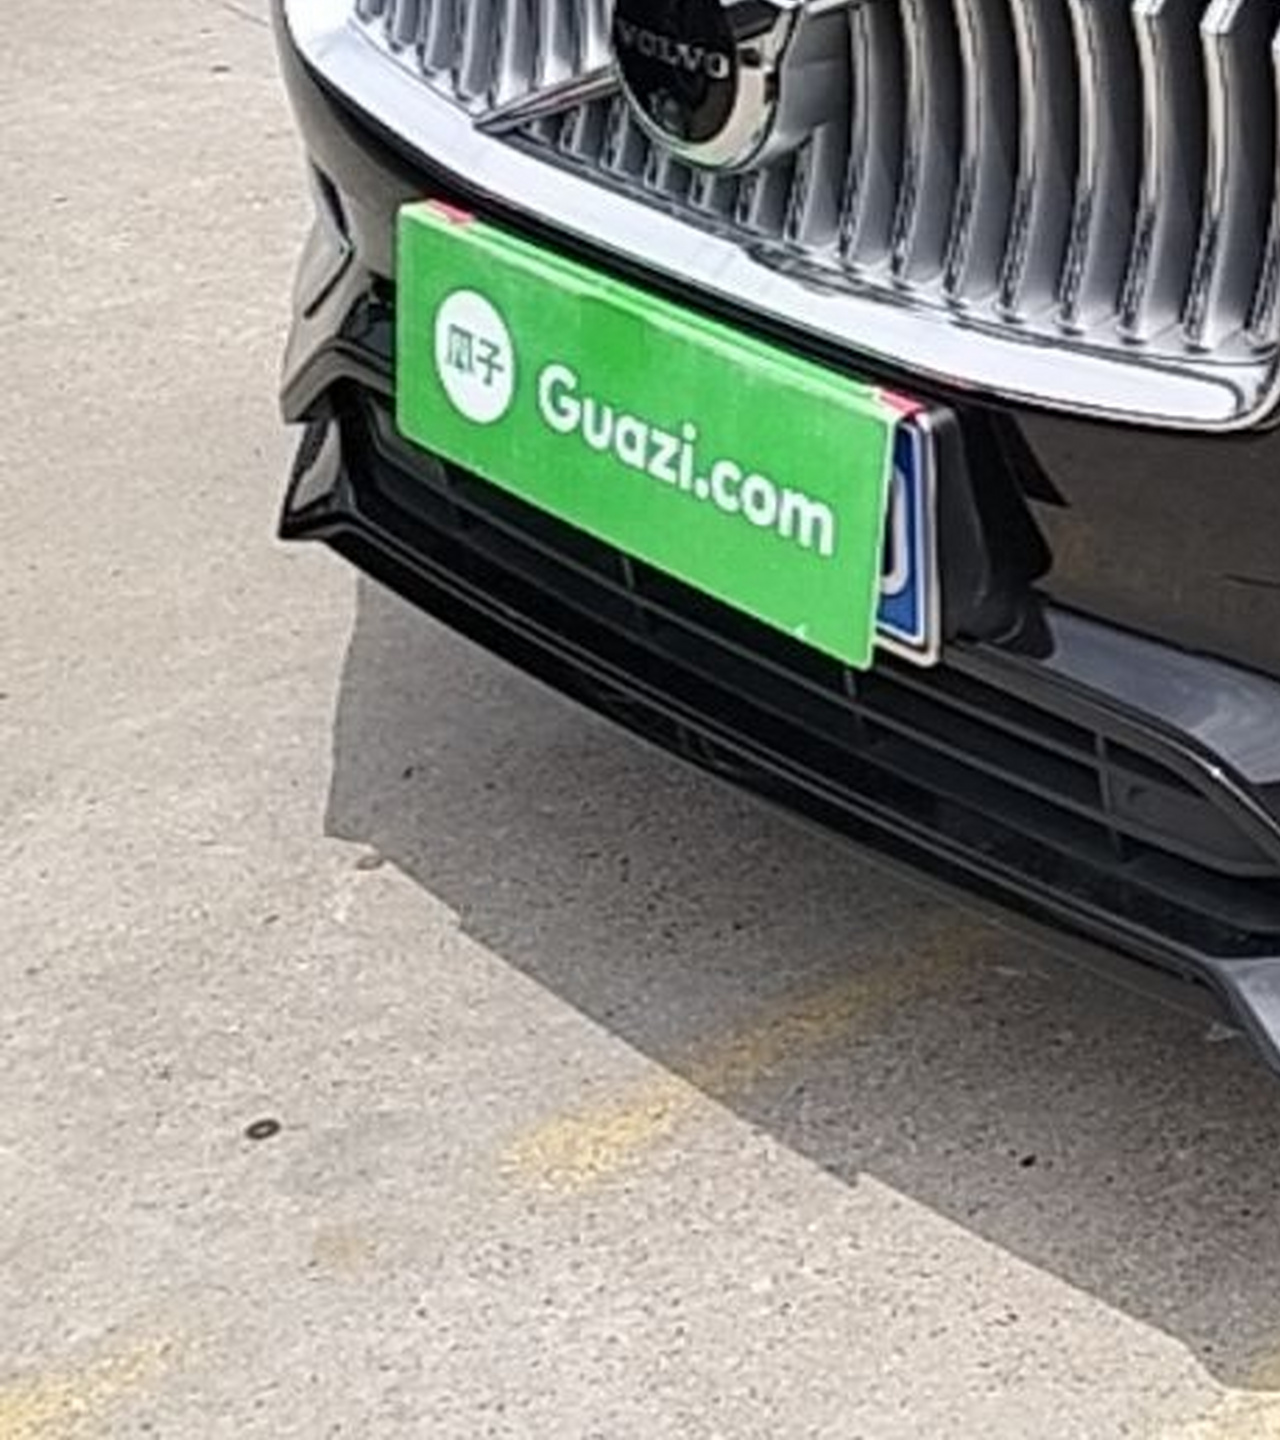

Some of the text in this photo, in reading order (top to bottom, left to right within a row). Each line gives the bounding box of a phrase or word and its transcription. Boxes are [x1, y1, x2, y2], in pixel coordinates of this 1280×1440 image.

[616, 17, 729, 80] VOLVO
[447, 323, 505, 387] 瓜子
[539, 364, 834, 556] Guazi.com
